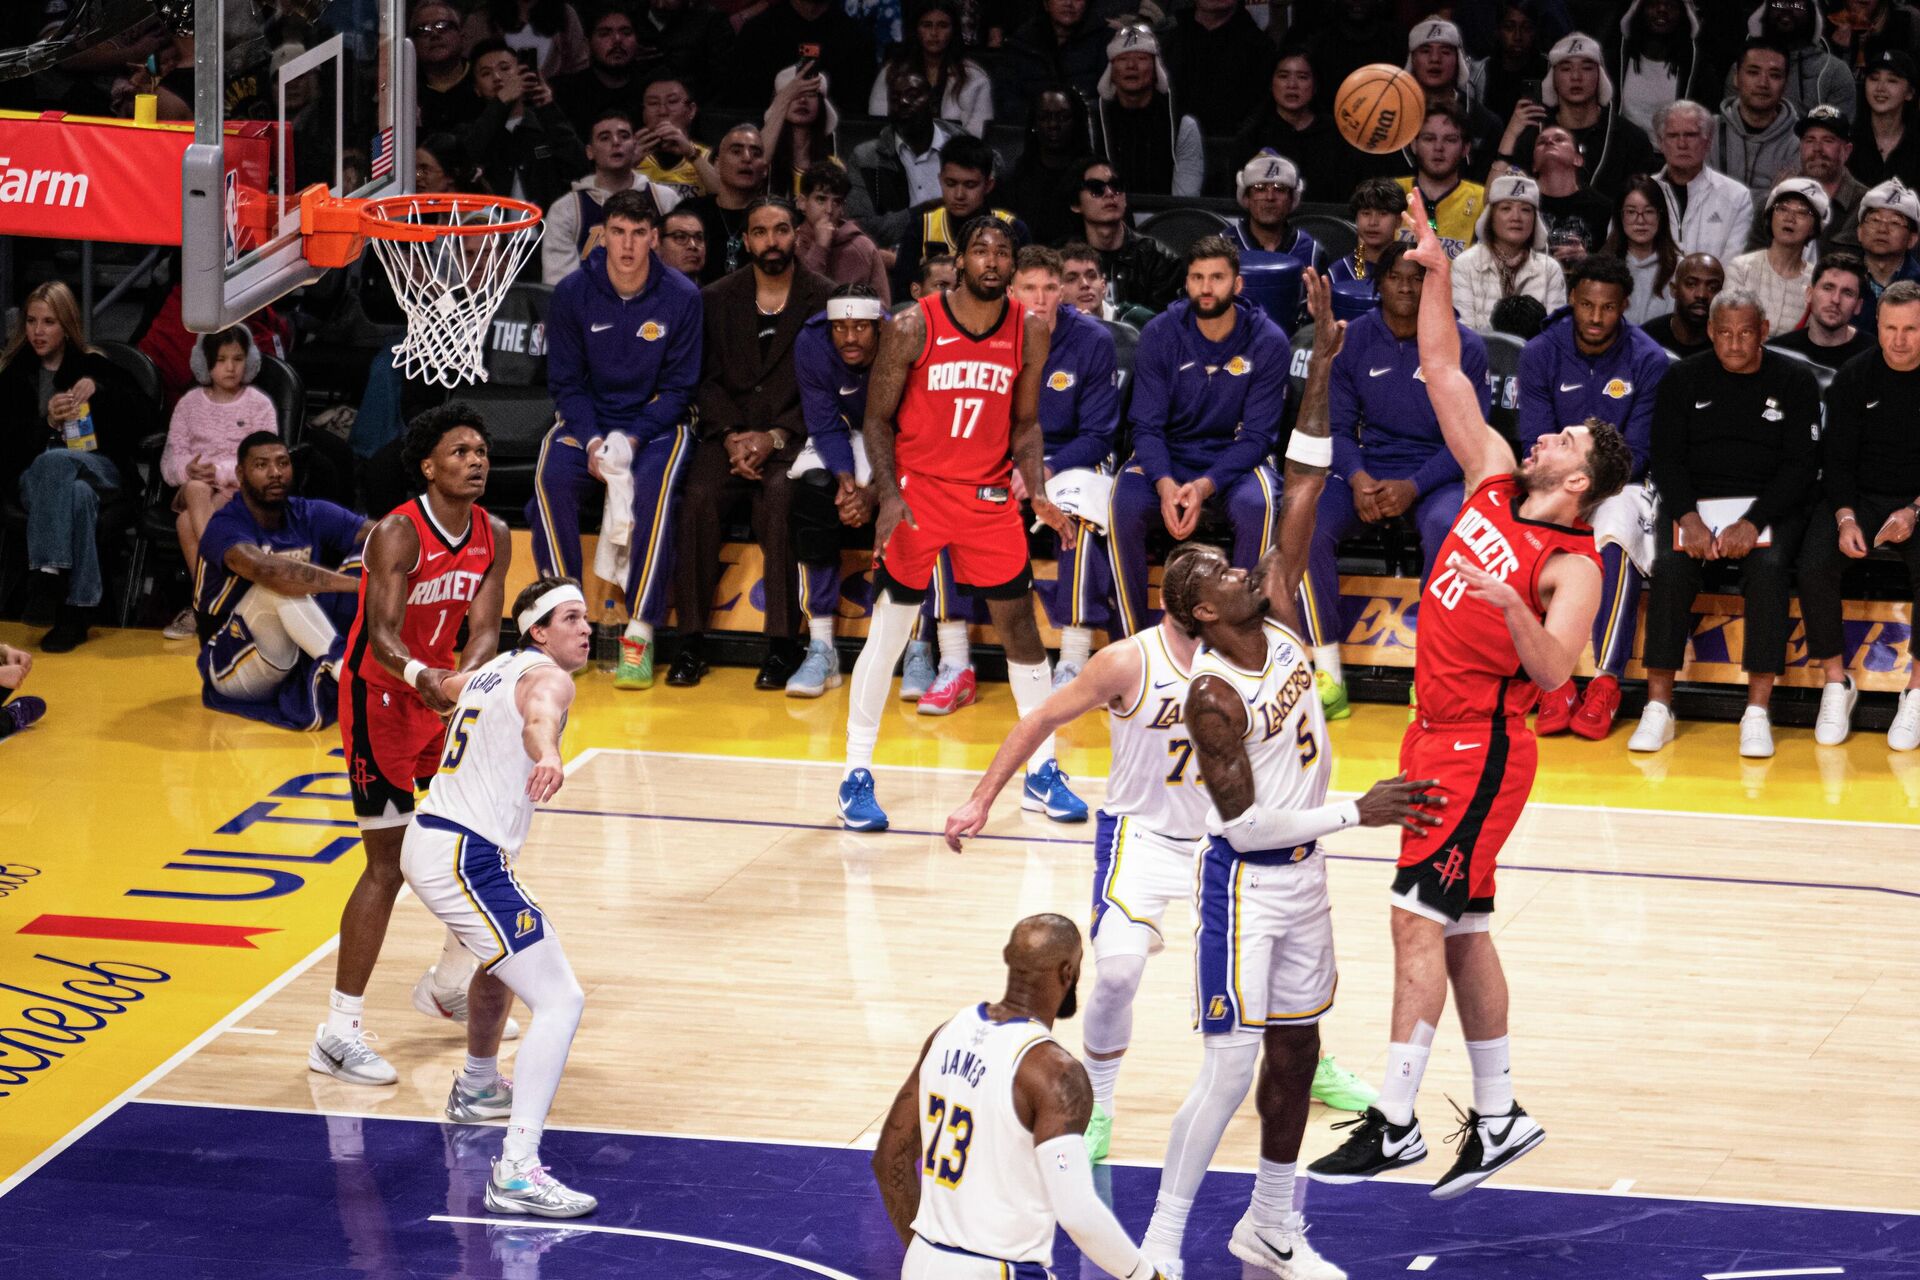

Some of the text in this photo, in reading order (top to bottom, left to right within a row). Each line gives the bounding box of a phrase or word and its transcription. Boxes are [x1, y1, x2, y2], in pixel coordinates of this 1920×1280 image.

[492, 320, 528, 354] THE
[927, 360, 1013, 395] ROCKETS
[950, 397, 984, 439] 17
[406, 570, 484, 605] ROCKET
[428, 608, 448, 647] 1
[1256, 661, 1312, 743] LAKERS
[1166, 737, 1206, 787] 7
[1295, 711, 1320, 774] 5
[941, 1049, 986, 1089] JAMES
[922, 1091, 974, 1192] 23
